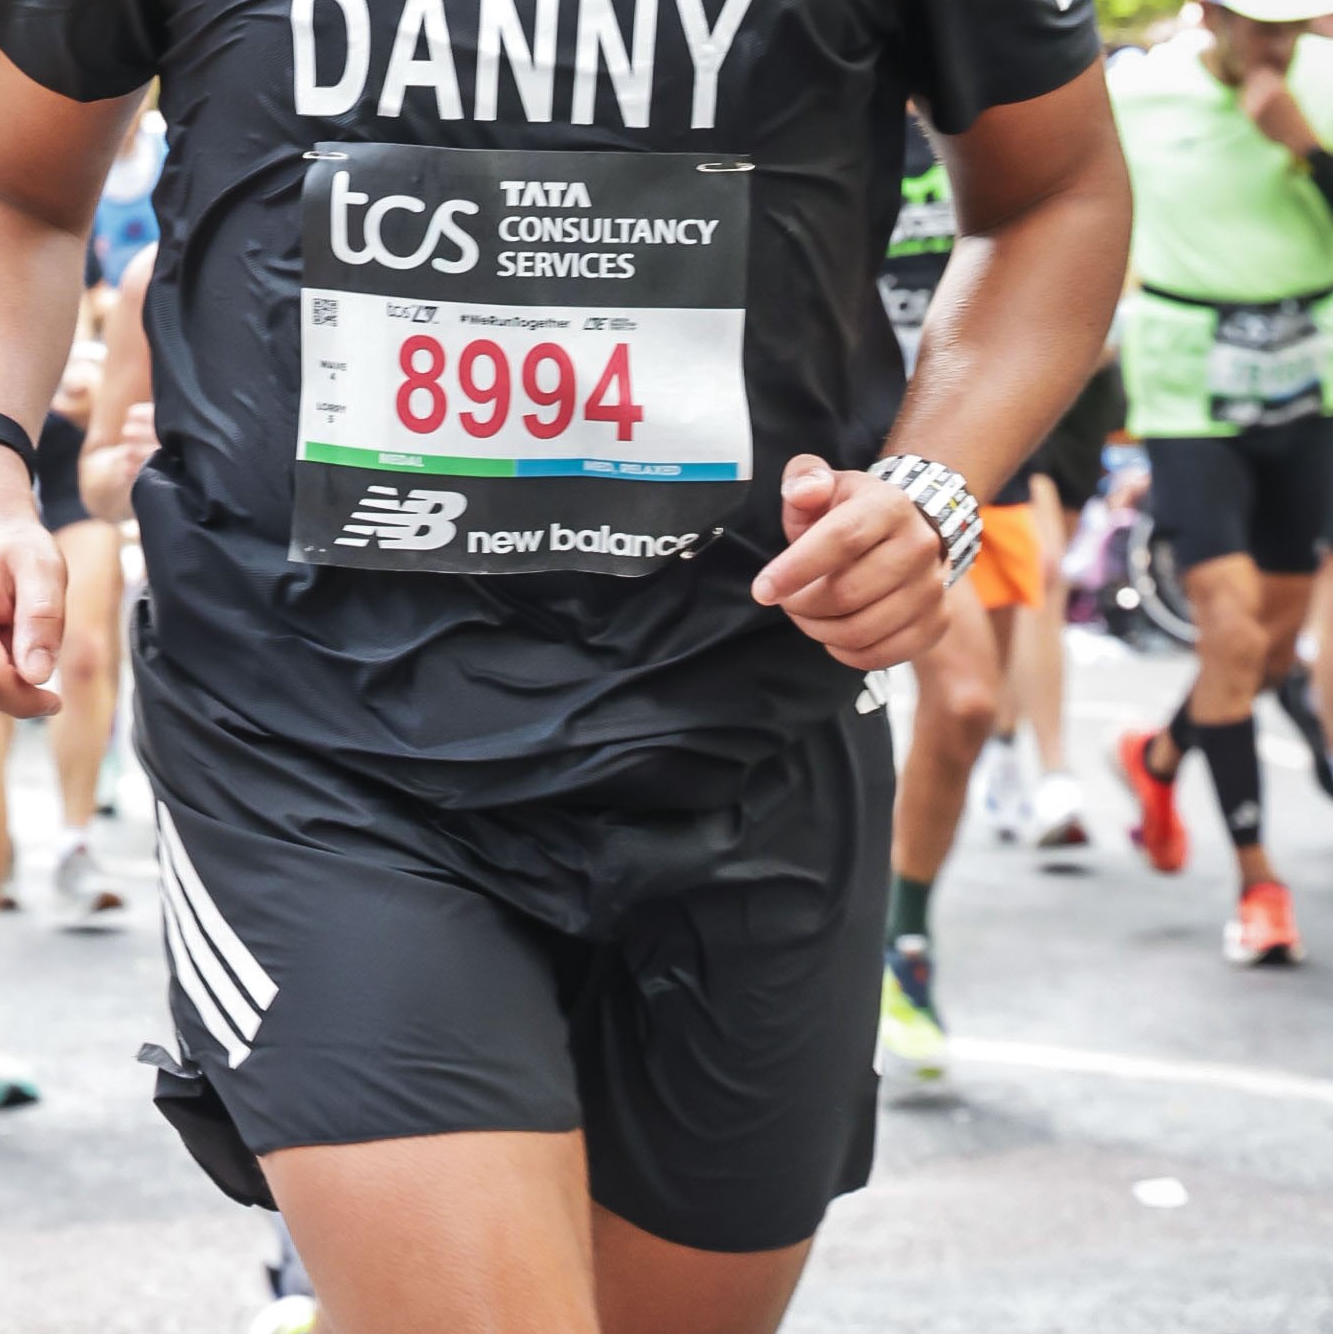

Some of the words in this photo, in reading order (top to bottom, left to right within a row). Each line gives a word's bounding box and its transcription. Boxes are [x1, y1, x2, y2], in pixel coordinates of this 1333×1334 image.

[498, 180, 593, 208] TATA
[330, 170, 480, 274] tcs
[497, 215, 719, 245] CONSULTANCY
[496, 251, 636, 279] SERVICES
[396, 335, 644, 441] 8994
[468, 528, 544, 554] new
